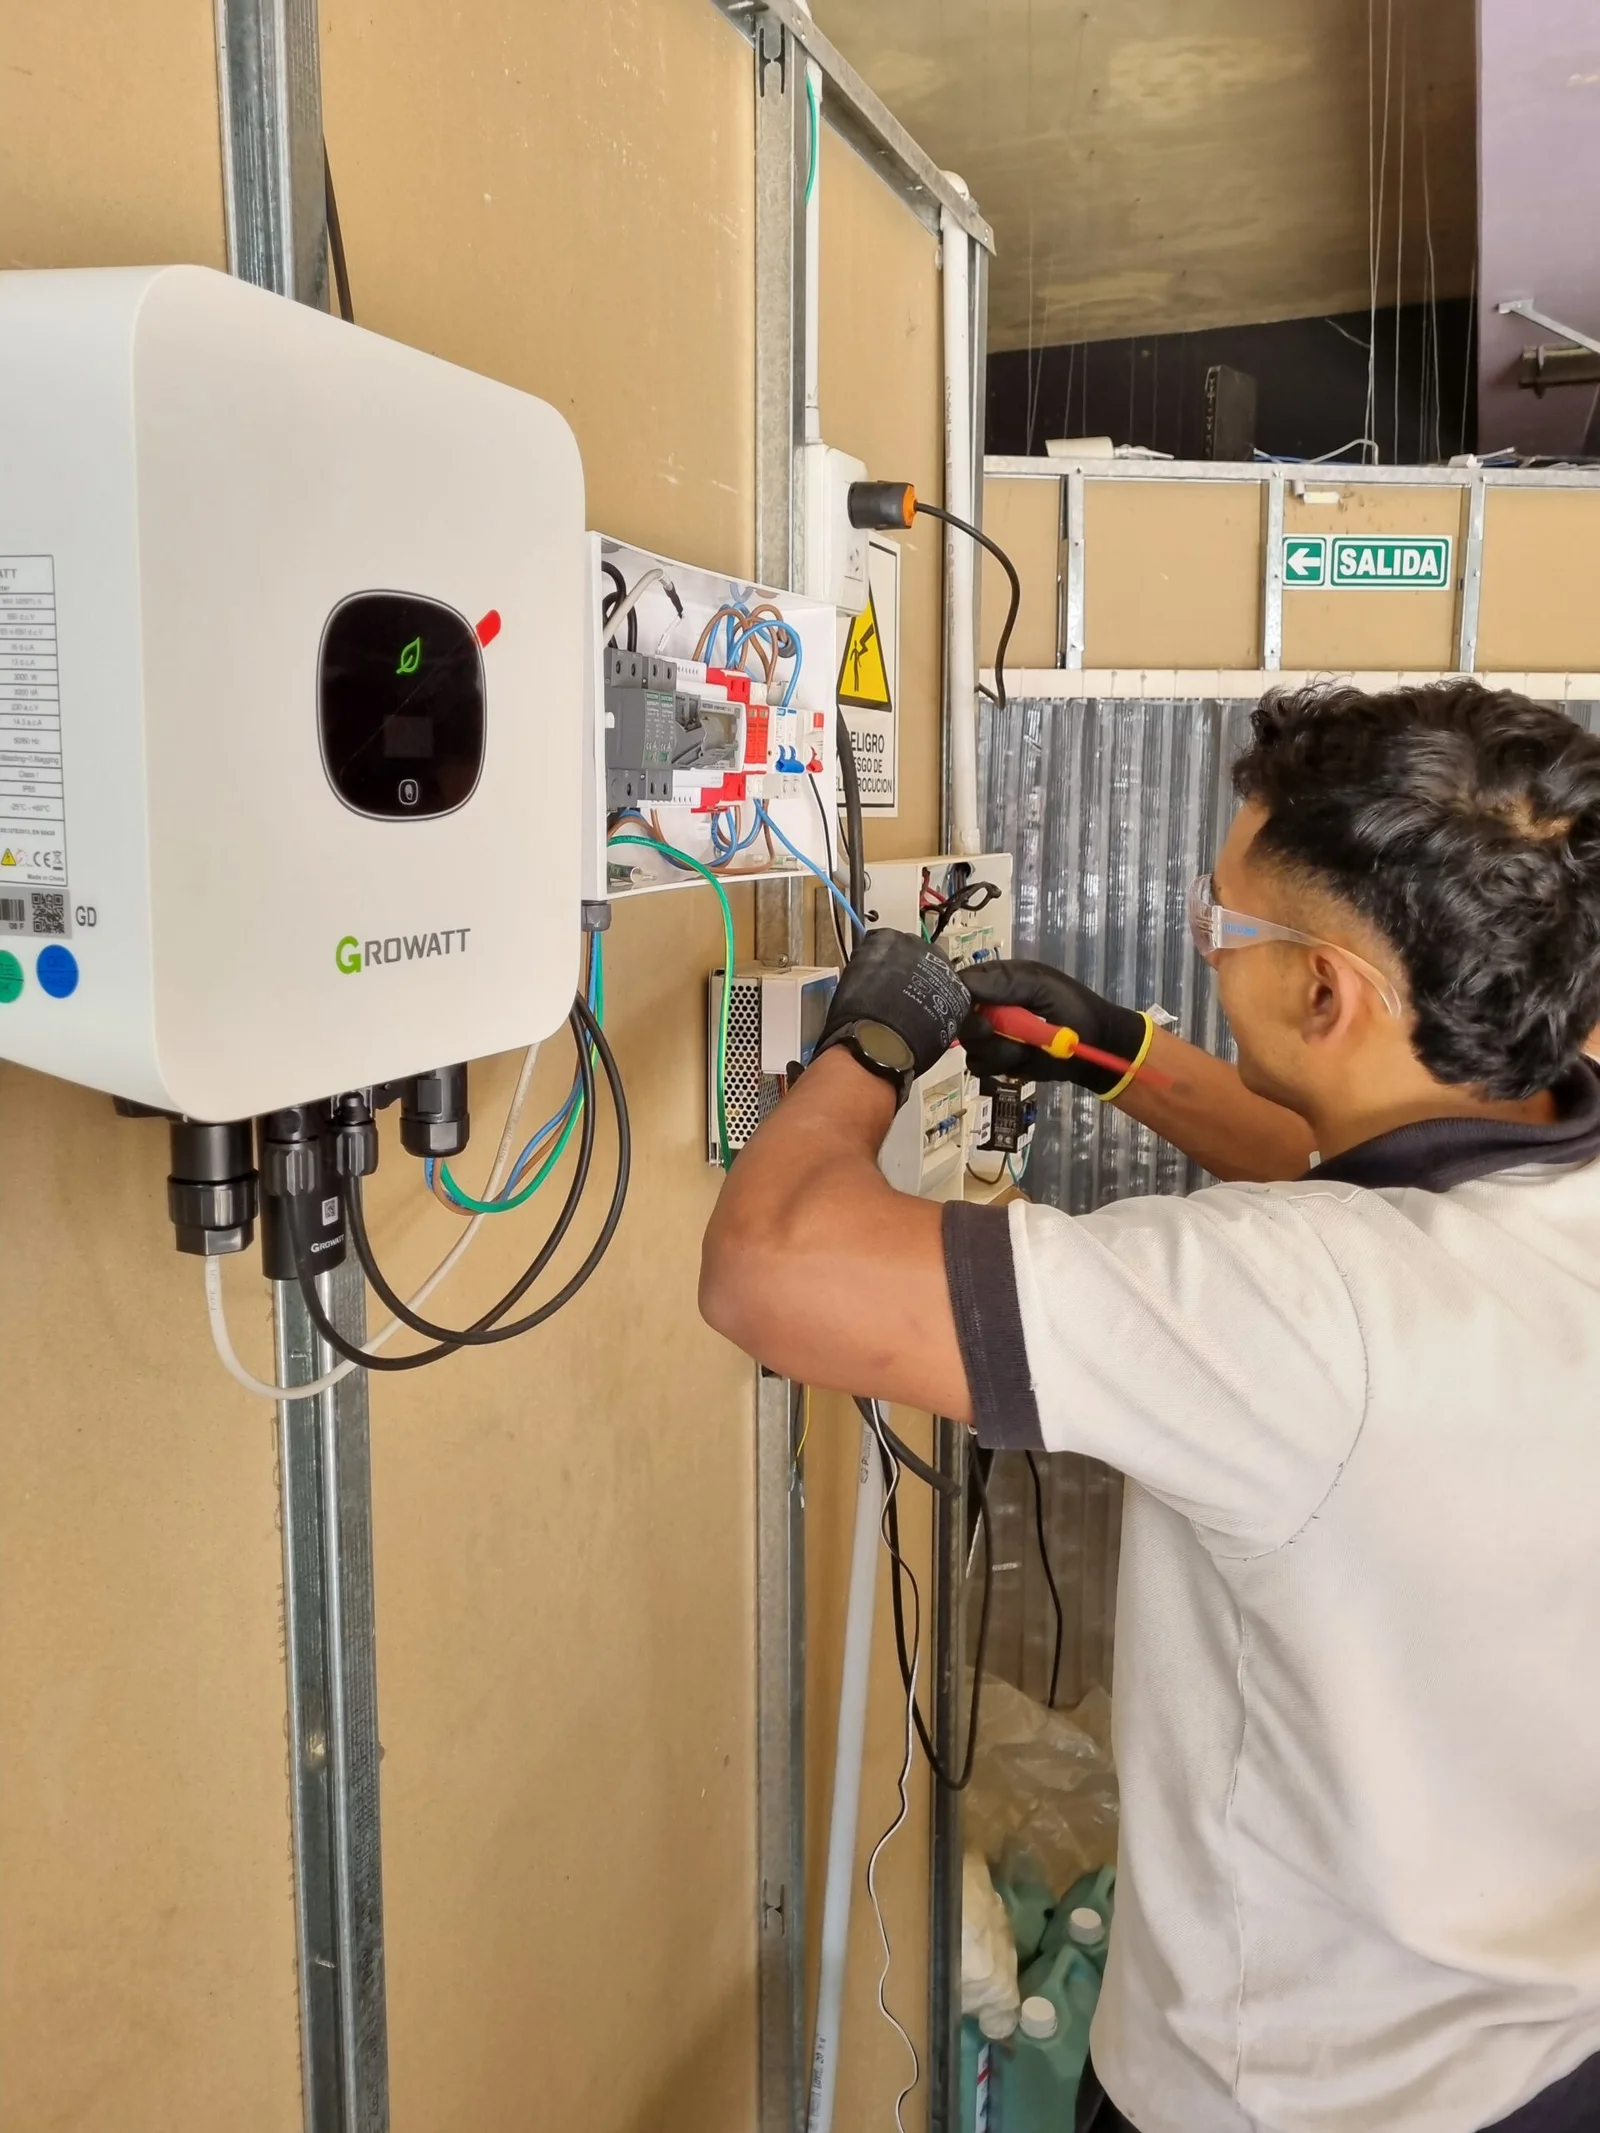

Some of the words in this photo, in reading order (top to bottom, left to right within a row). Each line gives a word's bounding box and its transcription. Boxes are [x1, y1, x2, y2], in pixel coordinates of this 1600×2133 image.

[1339, 547, 1439, 577] SALIDA
[850, 730, 885, 754] ELIGRO
[873, 758, 883, 774] DE
[27, 873, 41, 881] Made
[48, 874, 65, 882] China
[75, 905, 97, 928] GD
[335, 928, 471, 975] GROWATT
[311, 1234, 345, 1254] GROWATT
